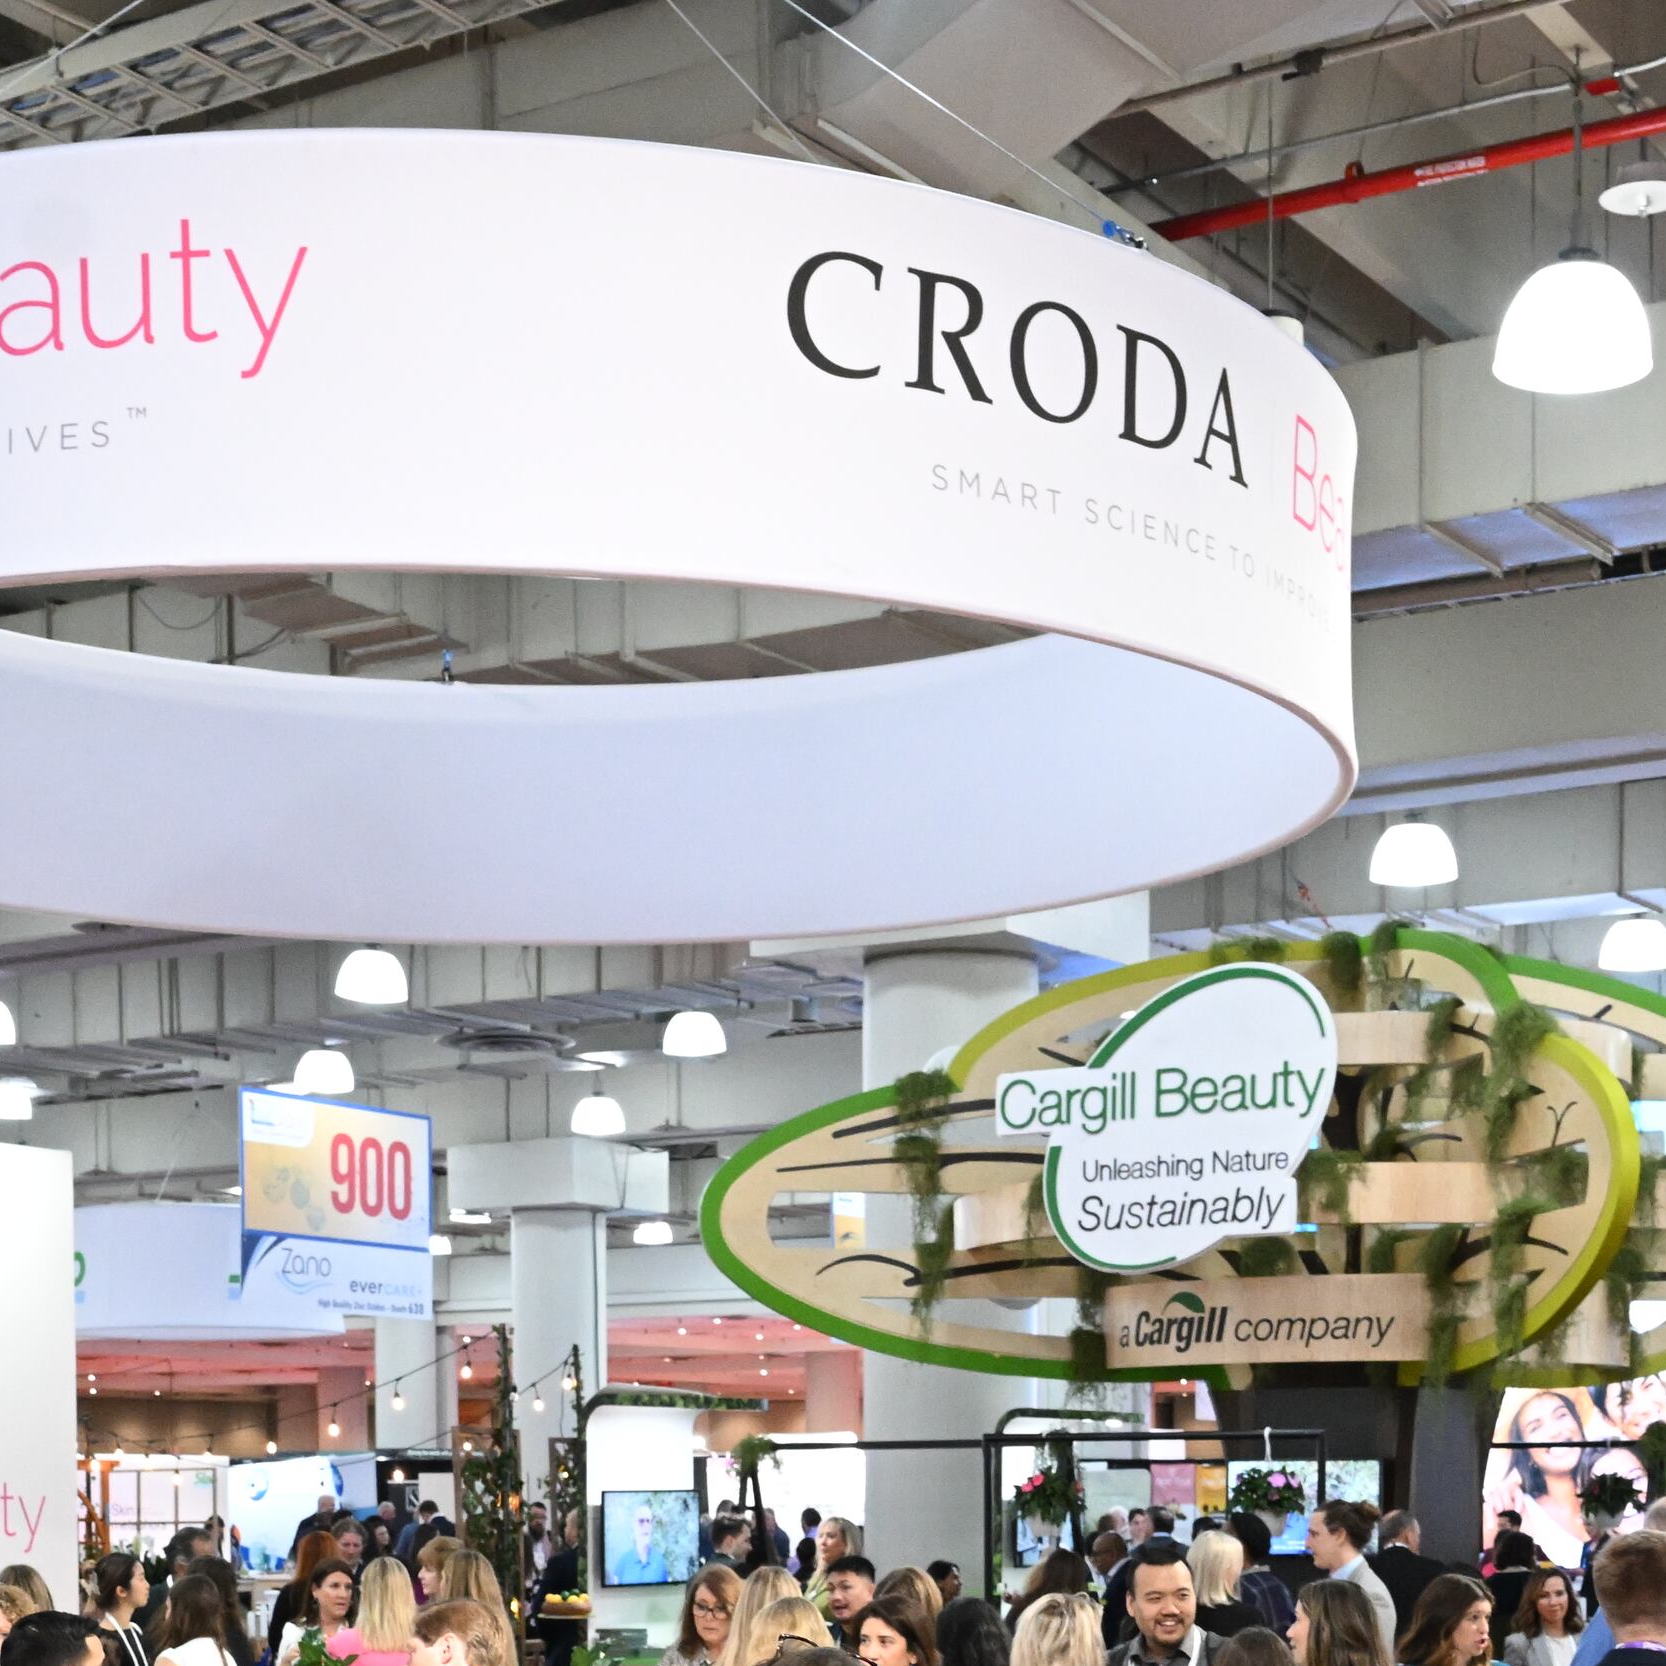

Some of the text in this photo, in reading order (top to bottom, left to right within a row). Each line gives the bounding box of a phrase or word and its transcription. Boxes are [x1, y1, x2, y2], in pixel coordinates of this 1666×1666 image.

[786, 250, 1345, 572] CRODA Bea
[931, 463, 1063, 515] SMART
[1084, 497, 1218, 562] SCIENCE
[1229, 544, 1256, 579] TO
[1000, 1058, 1326, 1135] Cargill Beauty
[330, 1132, 413, 1221] 900
[1082, 1148, 1290, 1185] Unleashing Nature
[1078, 1186, 1286, 1234] Sustainably
[281, 1247, 332, 1278] Zano
[1118, 1305, 1395, 1352] a Cargill company
